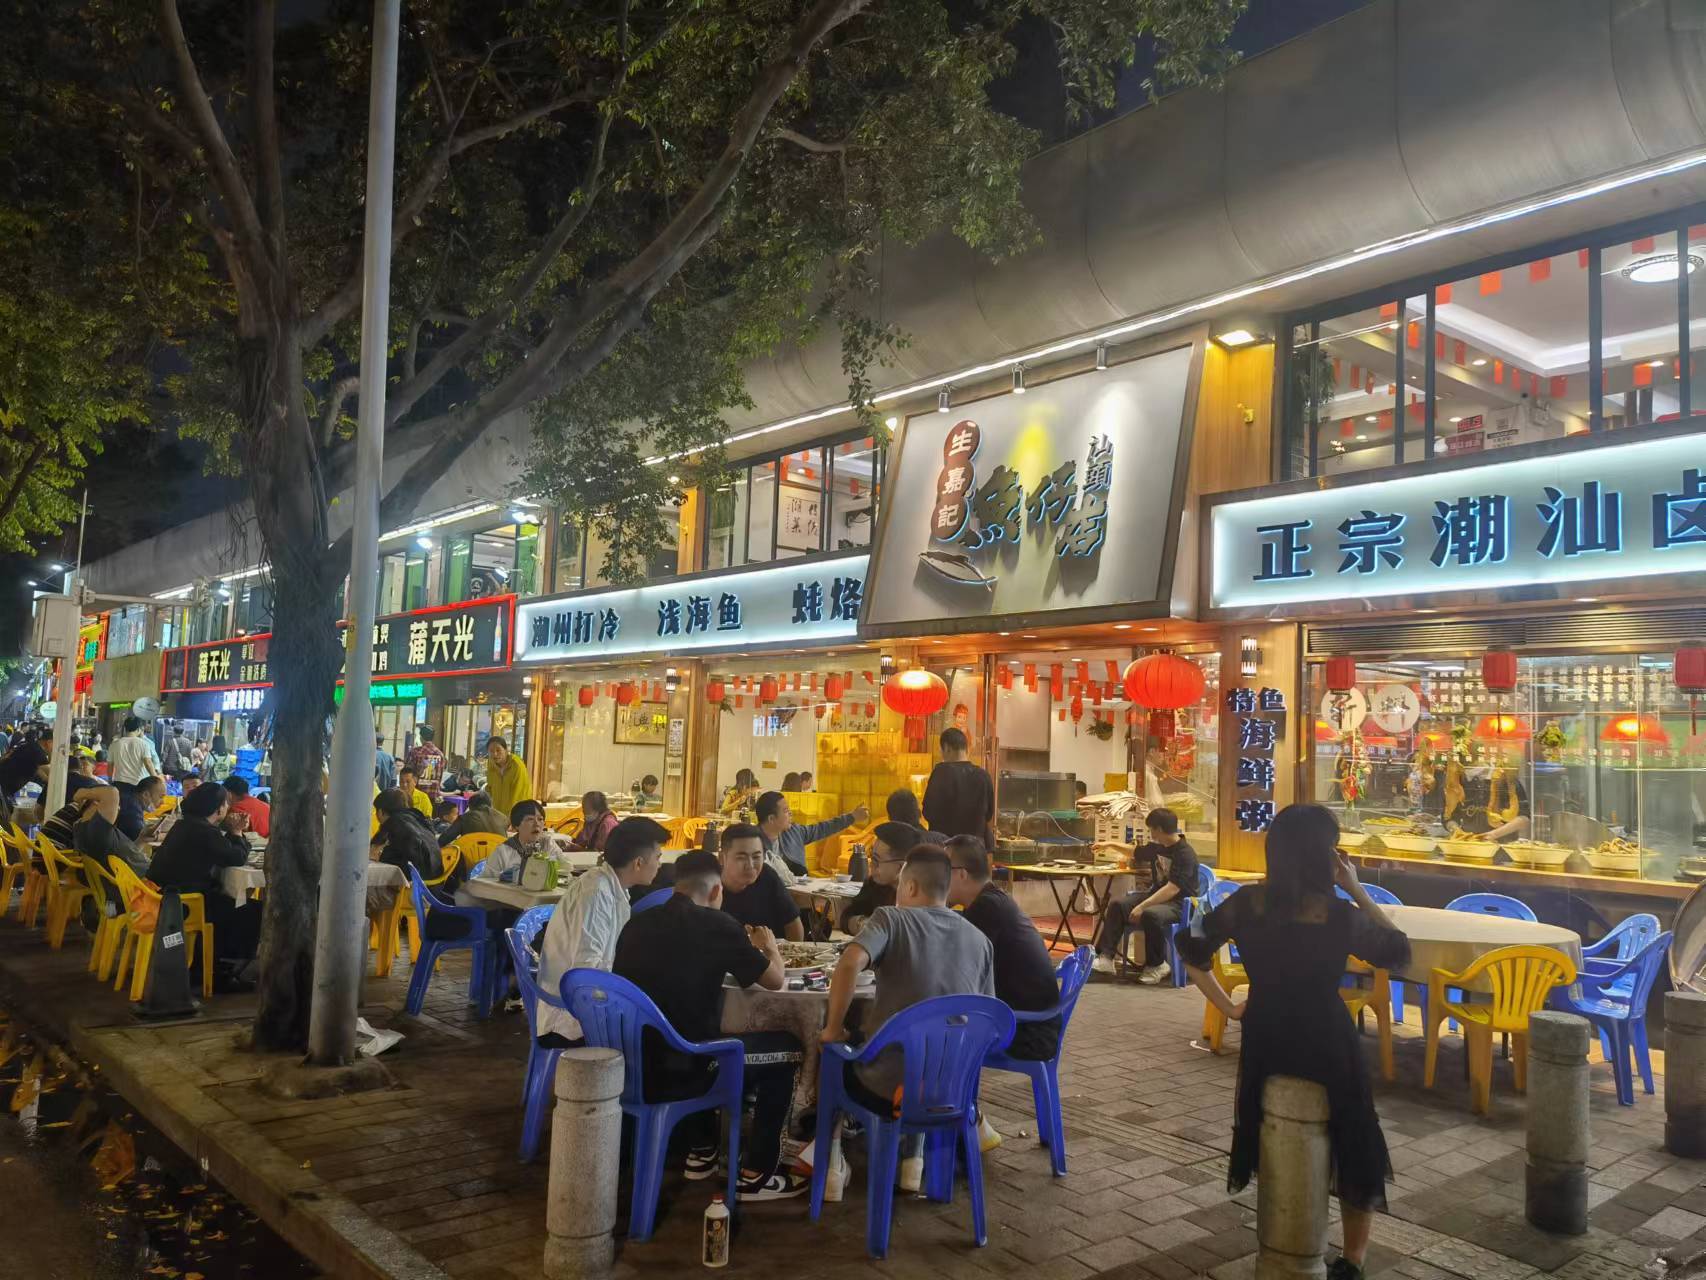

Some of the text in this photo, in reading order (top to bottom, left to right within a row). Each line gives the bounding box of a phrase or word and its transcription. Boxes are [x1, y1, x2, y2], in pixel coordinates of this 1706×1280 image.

[937, 428, 974, 529] 生嘉記
[1252, 466, 1706, 583] 正宗潮汕卤
[657, 591, 743, 637] 浅海鱼
[791, 576, 865, 624] 蚝烙
[531, 607, 621, 649] 潮州打冷
[1226, 686, 1288, 713] 特色
